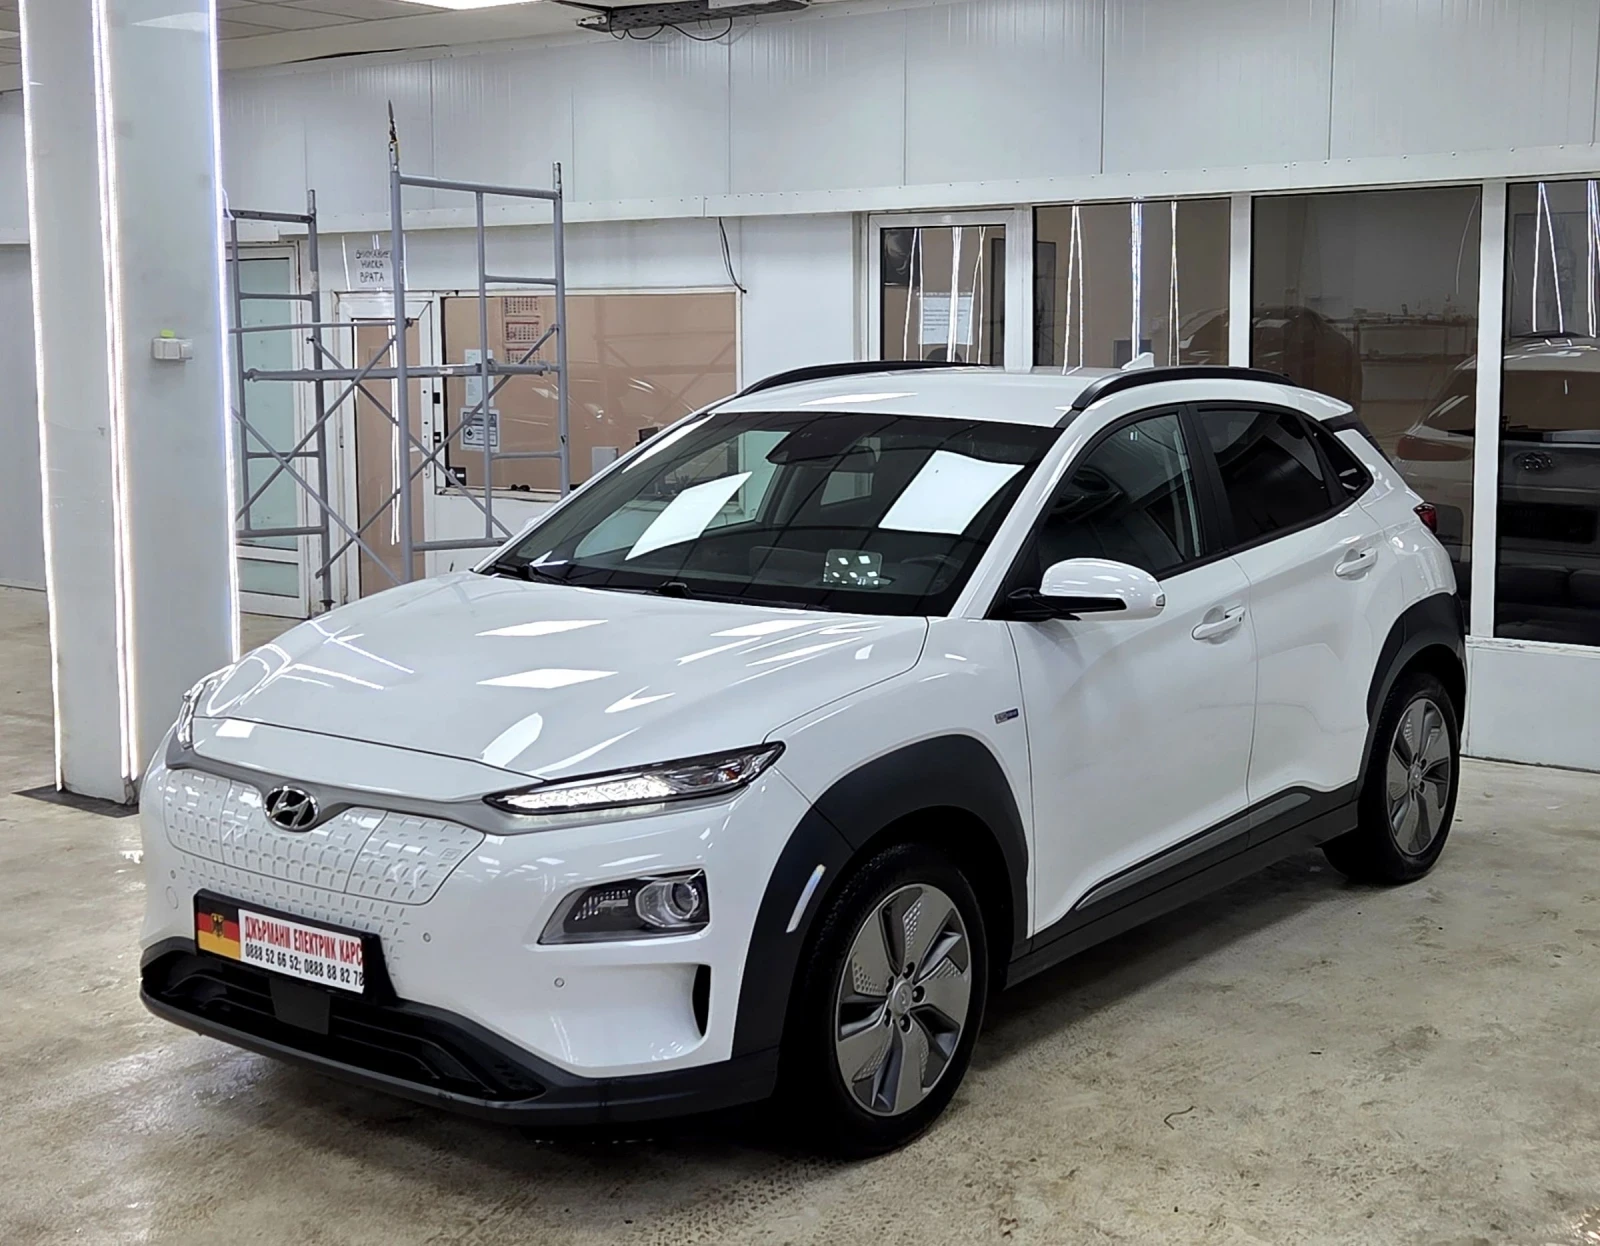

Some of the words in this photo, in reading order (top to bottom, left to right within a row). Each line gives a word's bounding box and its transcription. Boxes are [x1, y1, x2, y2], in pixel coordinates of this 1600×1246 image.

[360, 271, 385, 284] ВРАТА
[244, 915, 291, 949] ДЖЪРМАНИ
[293, 928, 337, 961] ЕЛЕКТРИК
[339, 939, 363, 967] КАРС
[245, 942, 263, 962] 0888
[265, 947, 275, 965] 52
[277, 951, 287, 968] 66
[289, 954, 302, 974] 52;
[303, 958, 324, 978] 0888
[326, 963, 337, 981] 88
[339, 967, 351, 984] 82
